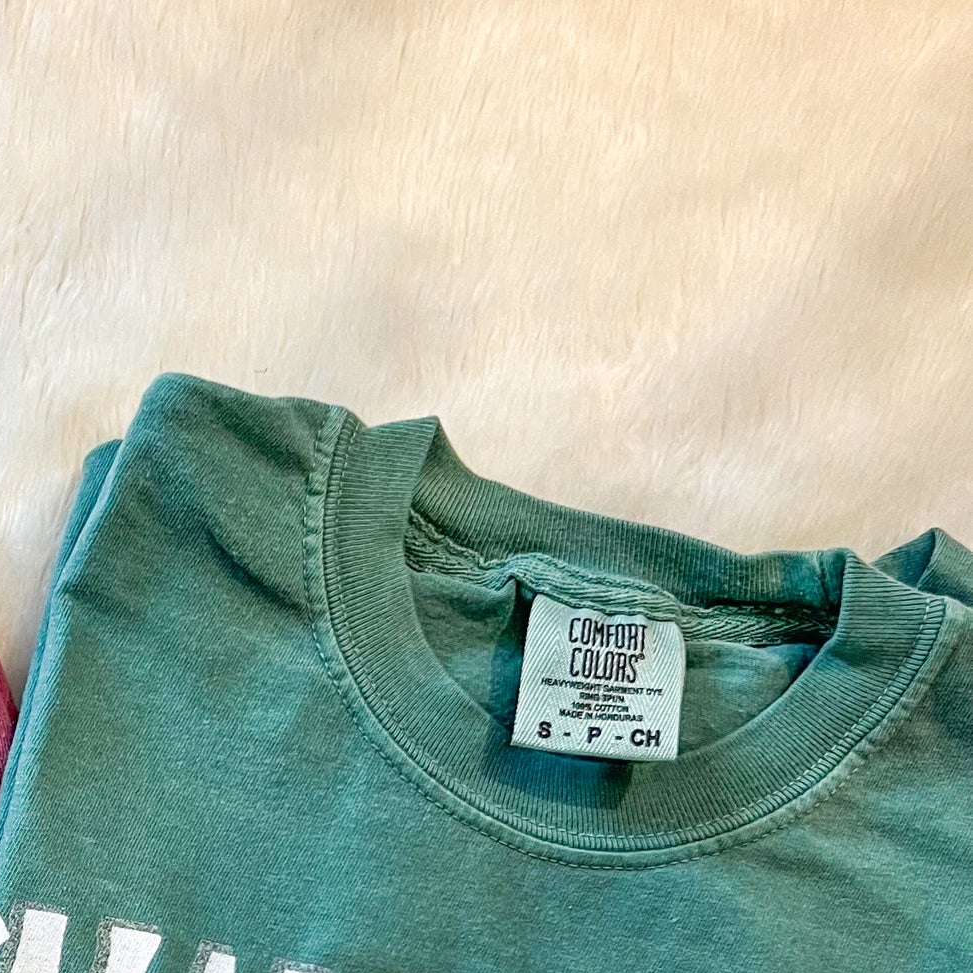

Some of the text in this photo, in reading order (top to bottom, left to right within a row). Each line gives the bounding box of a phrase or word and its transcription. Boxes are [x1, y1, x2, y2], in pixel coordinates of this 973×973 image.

[569, 617, 648, 652] COMFORT
[541, 678, 663, 696] HEAVYWEIGHT GARMENT DYE
[579, 693, 625, 703] RING SPUN
[572, 702, 629, 713] 100% COTTON
[559, 709, 644, 722] MADE IN HONDURAS
[537, 721, 552, 739] S
[587, 727, 602, 744] P
[630, 729, 660, 747] CH
